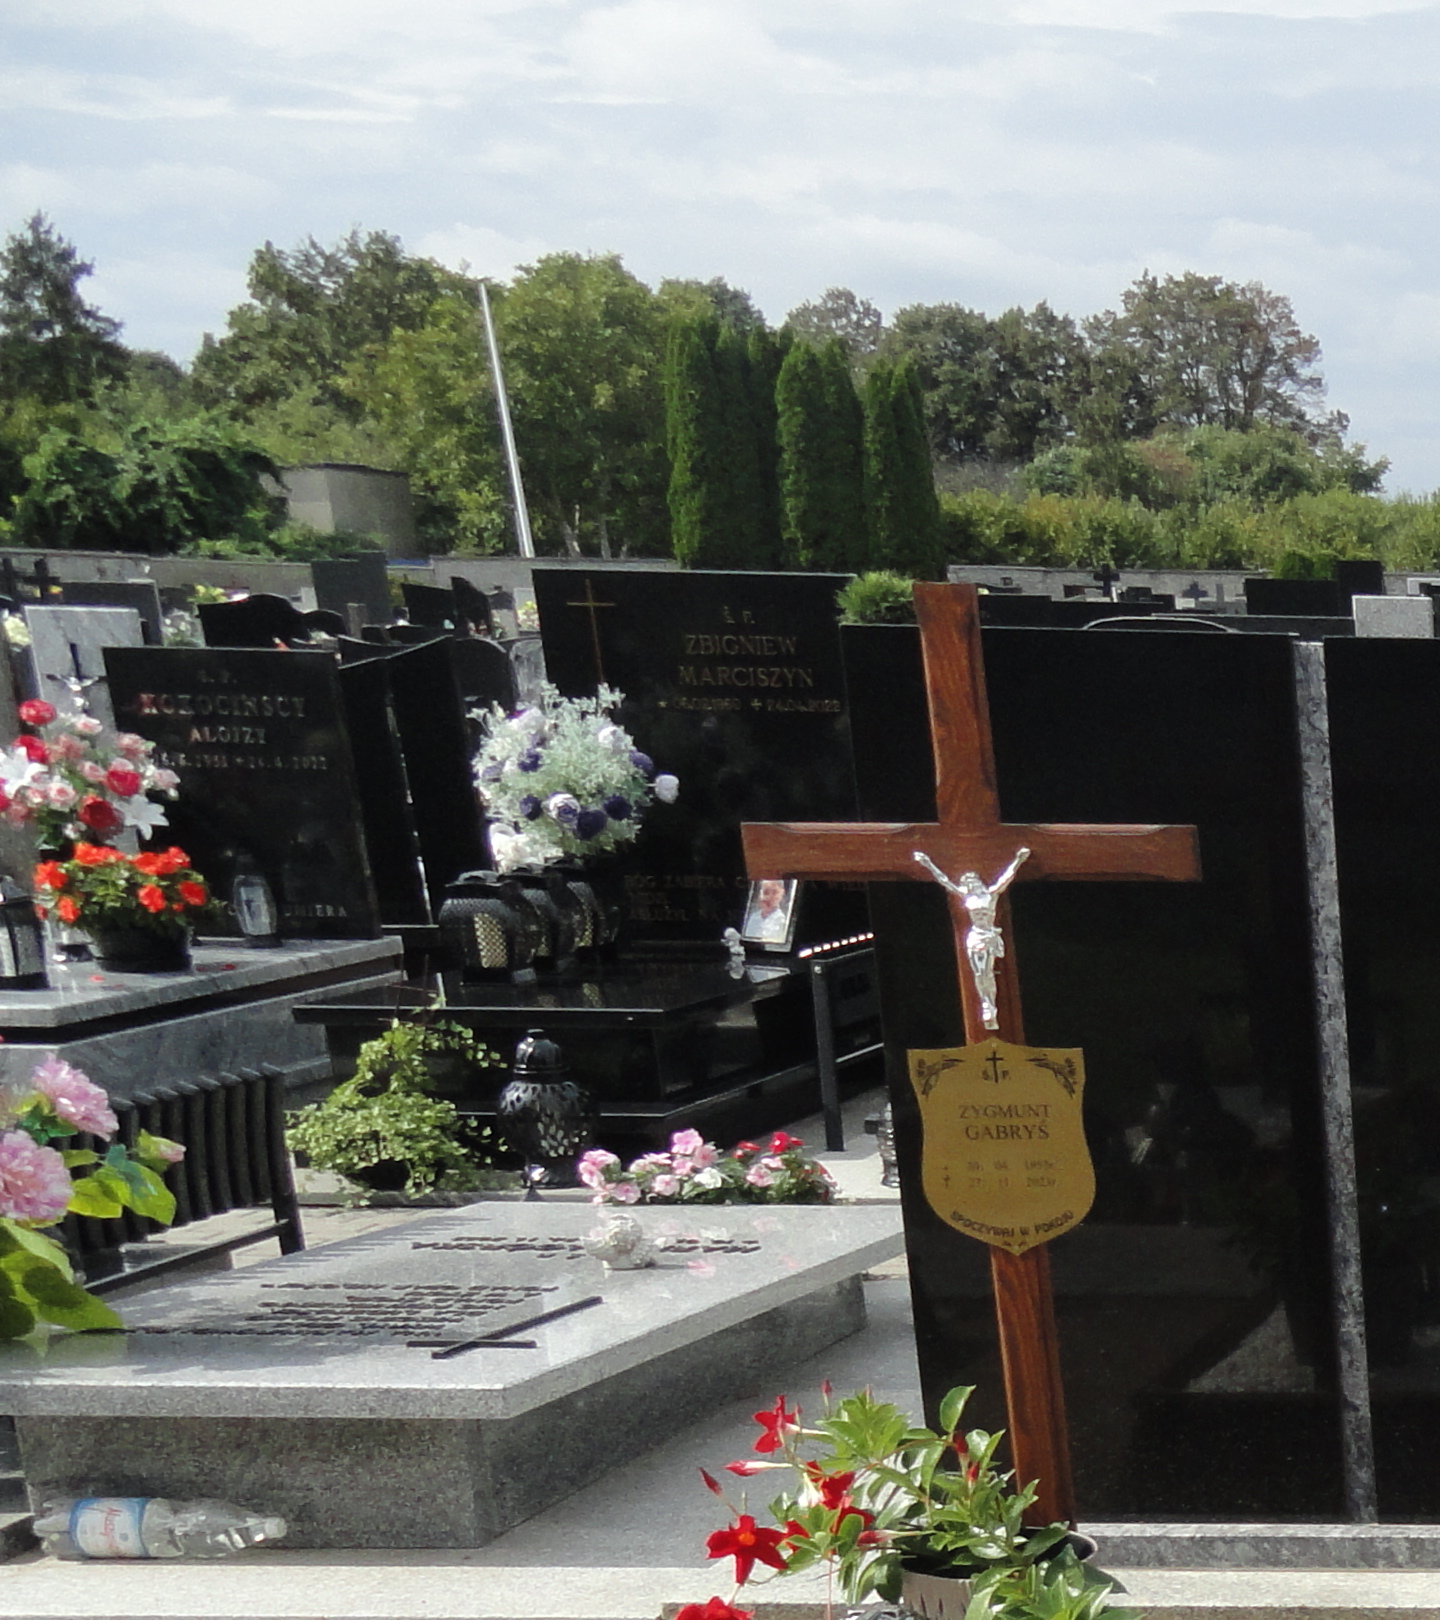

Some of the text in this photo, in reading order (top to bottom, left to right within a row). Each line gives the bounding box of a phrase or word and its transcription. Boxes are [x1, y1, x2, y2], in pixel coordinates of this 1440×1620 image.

[684, 633, 798, 656] ZBIGNIEW
[678, 665, 815, 688] MARCISZYN
[190, 726, 267, 745] ALOIZY
[958, 1104, 1051, 1119] ZYGMUNT
[965, 1120, 1050, 1140] GABRYŚ
